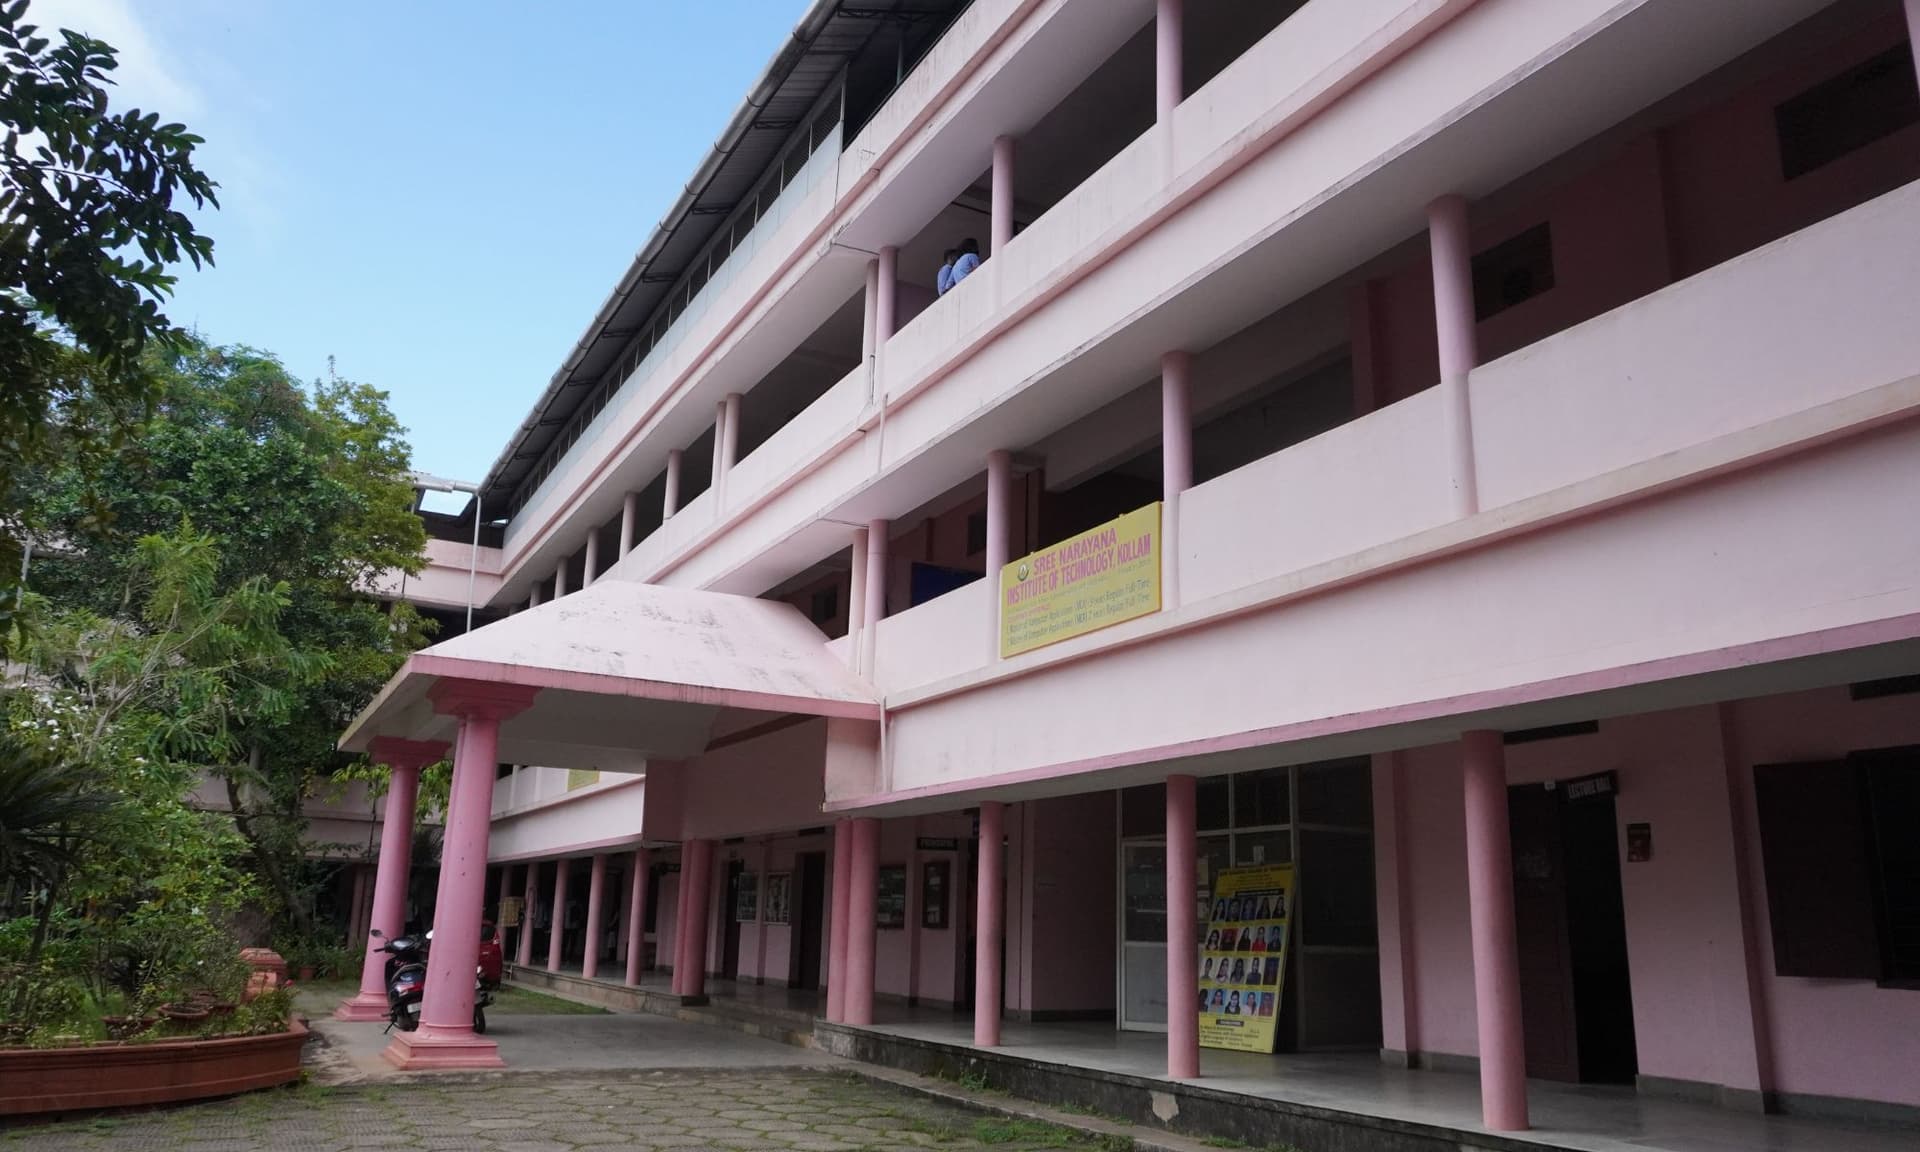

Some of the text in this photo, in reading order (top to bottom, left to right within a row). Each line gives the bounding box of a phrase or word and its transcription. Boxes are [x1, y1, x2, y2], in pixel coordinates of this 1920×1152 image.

[1007, 576, 1047, 606] INSTITUTE
[1049, 572, 1059, 590] OF
[1118, 534, 1150, 565] KOLLAM
[1034, 528, 1117, 576] SREE NARAYANA
